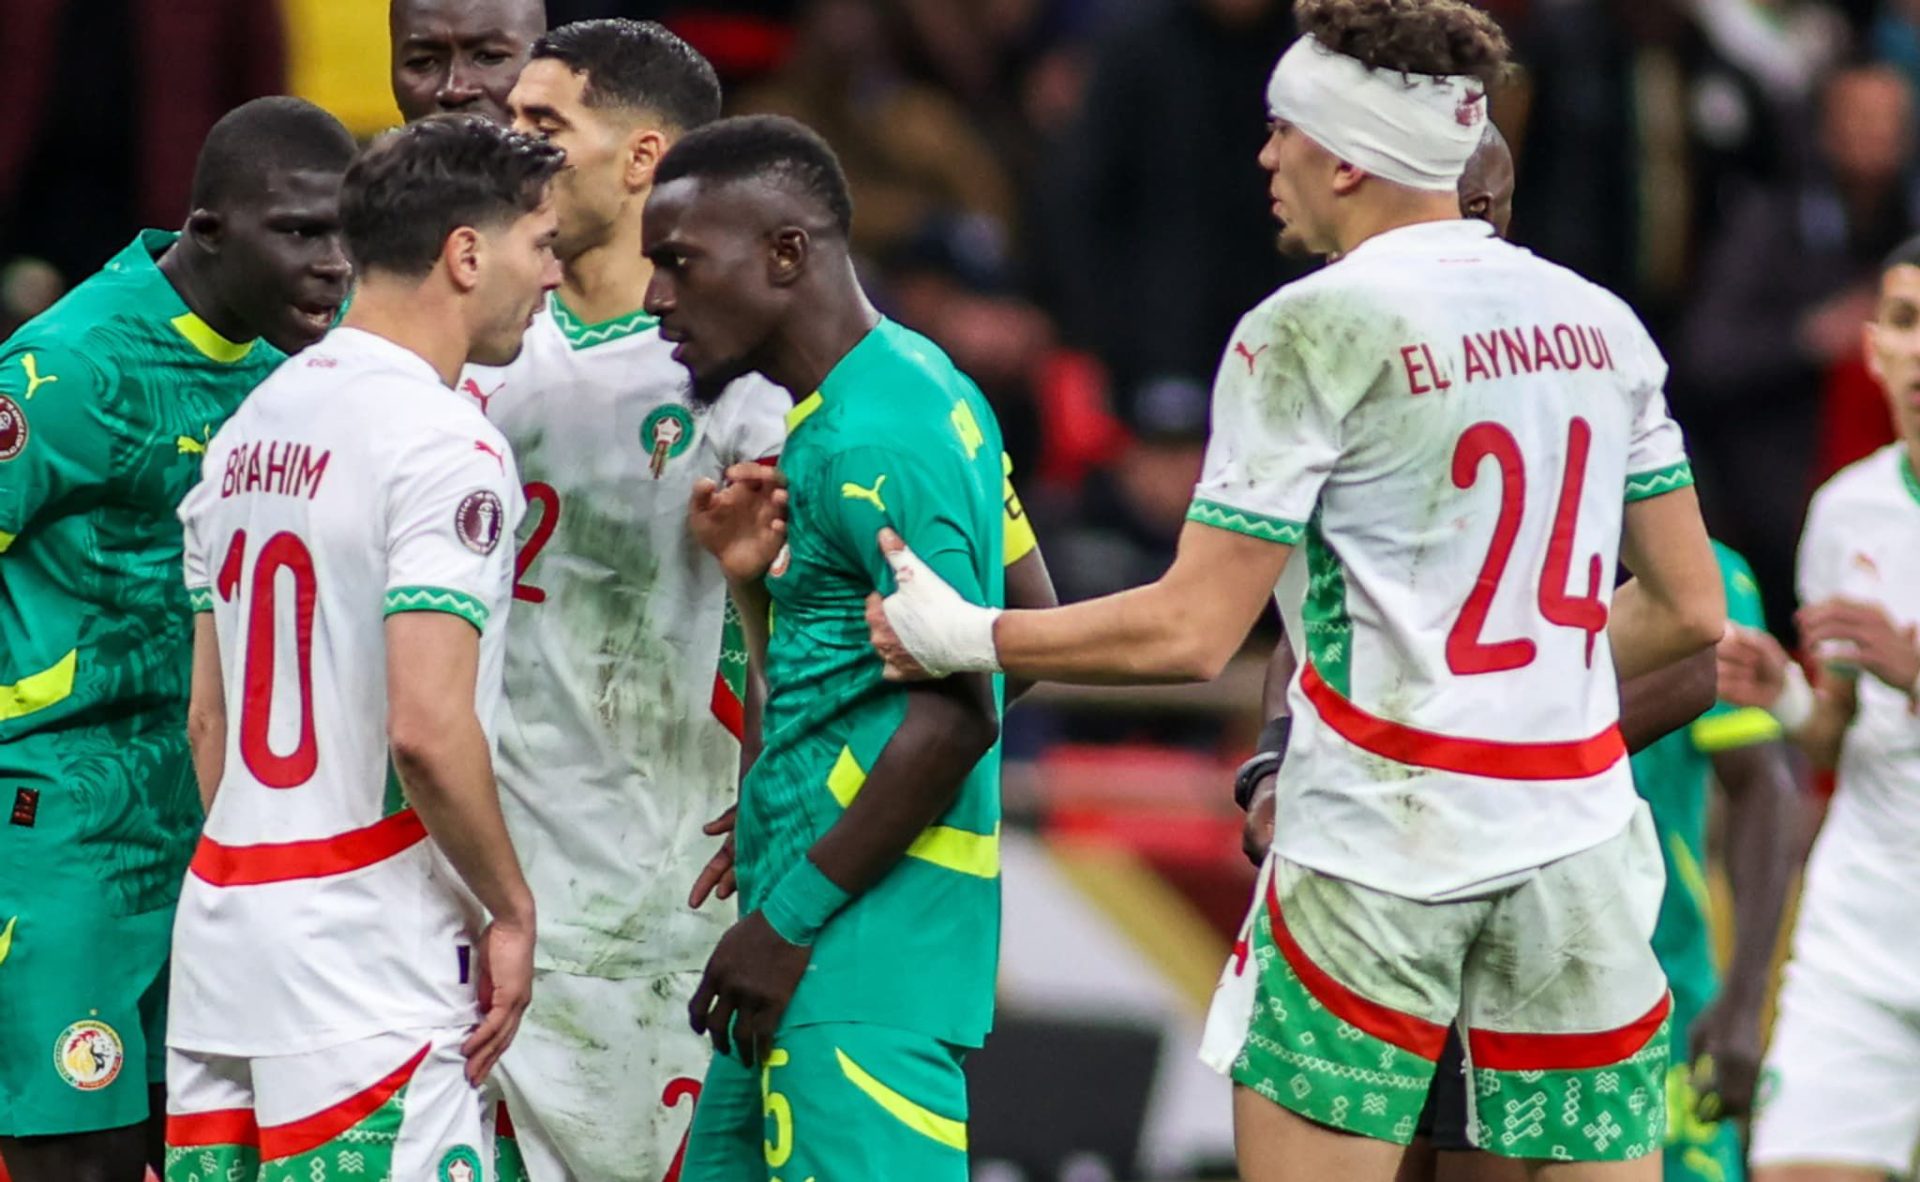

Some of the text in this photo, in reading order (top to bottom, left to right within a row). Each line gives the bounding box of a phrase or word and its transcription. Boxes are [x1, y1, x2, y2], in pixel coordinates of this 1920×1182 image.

[1400, 322, 1615, 395] EL AYNAOUI
[221, 439, 331, 500] BRAHIM
[512, 480, 560, 604] 2
[1445, 415, 1608, 675] 24
